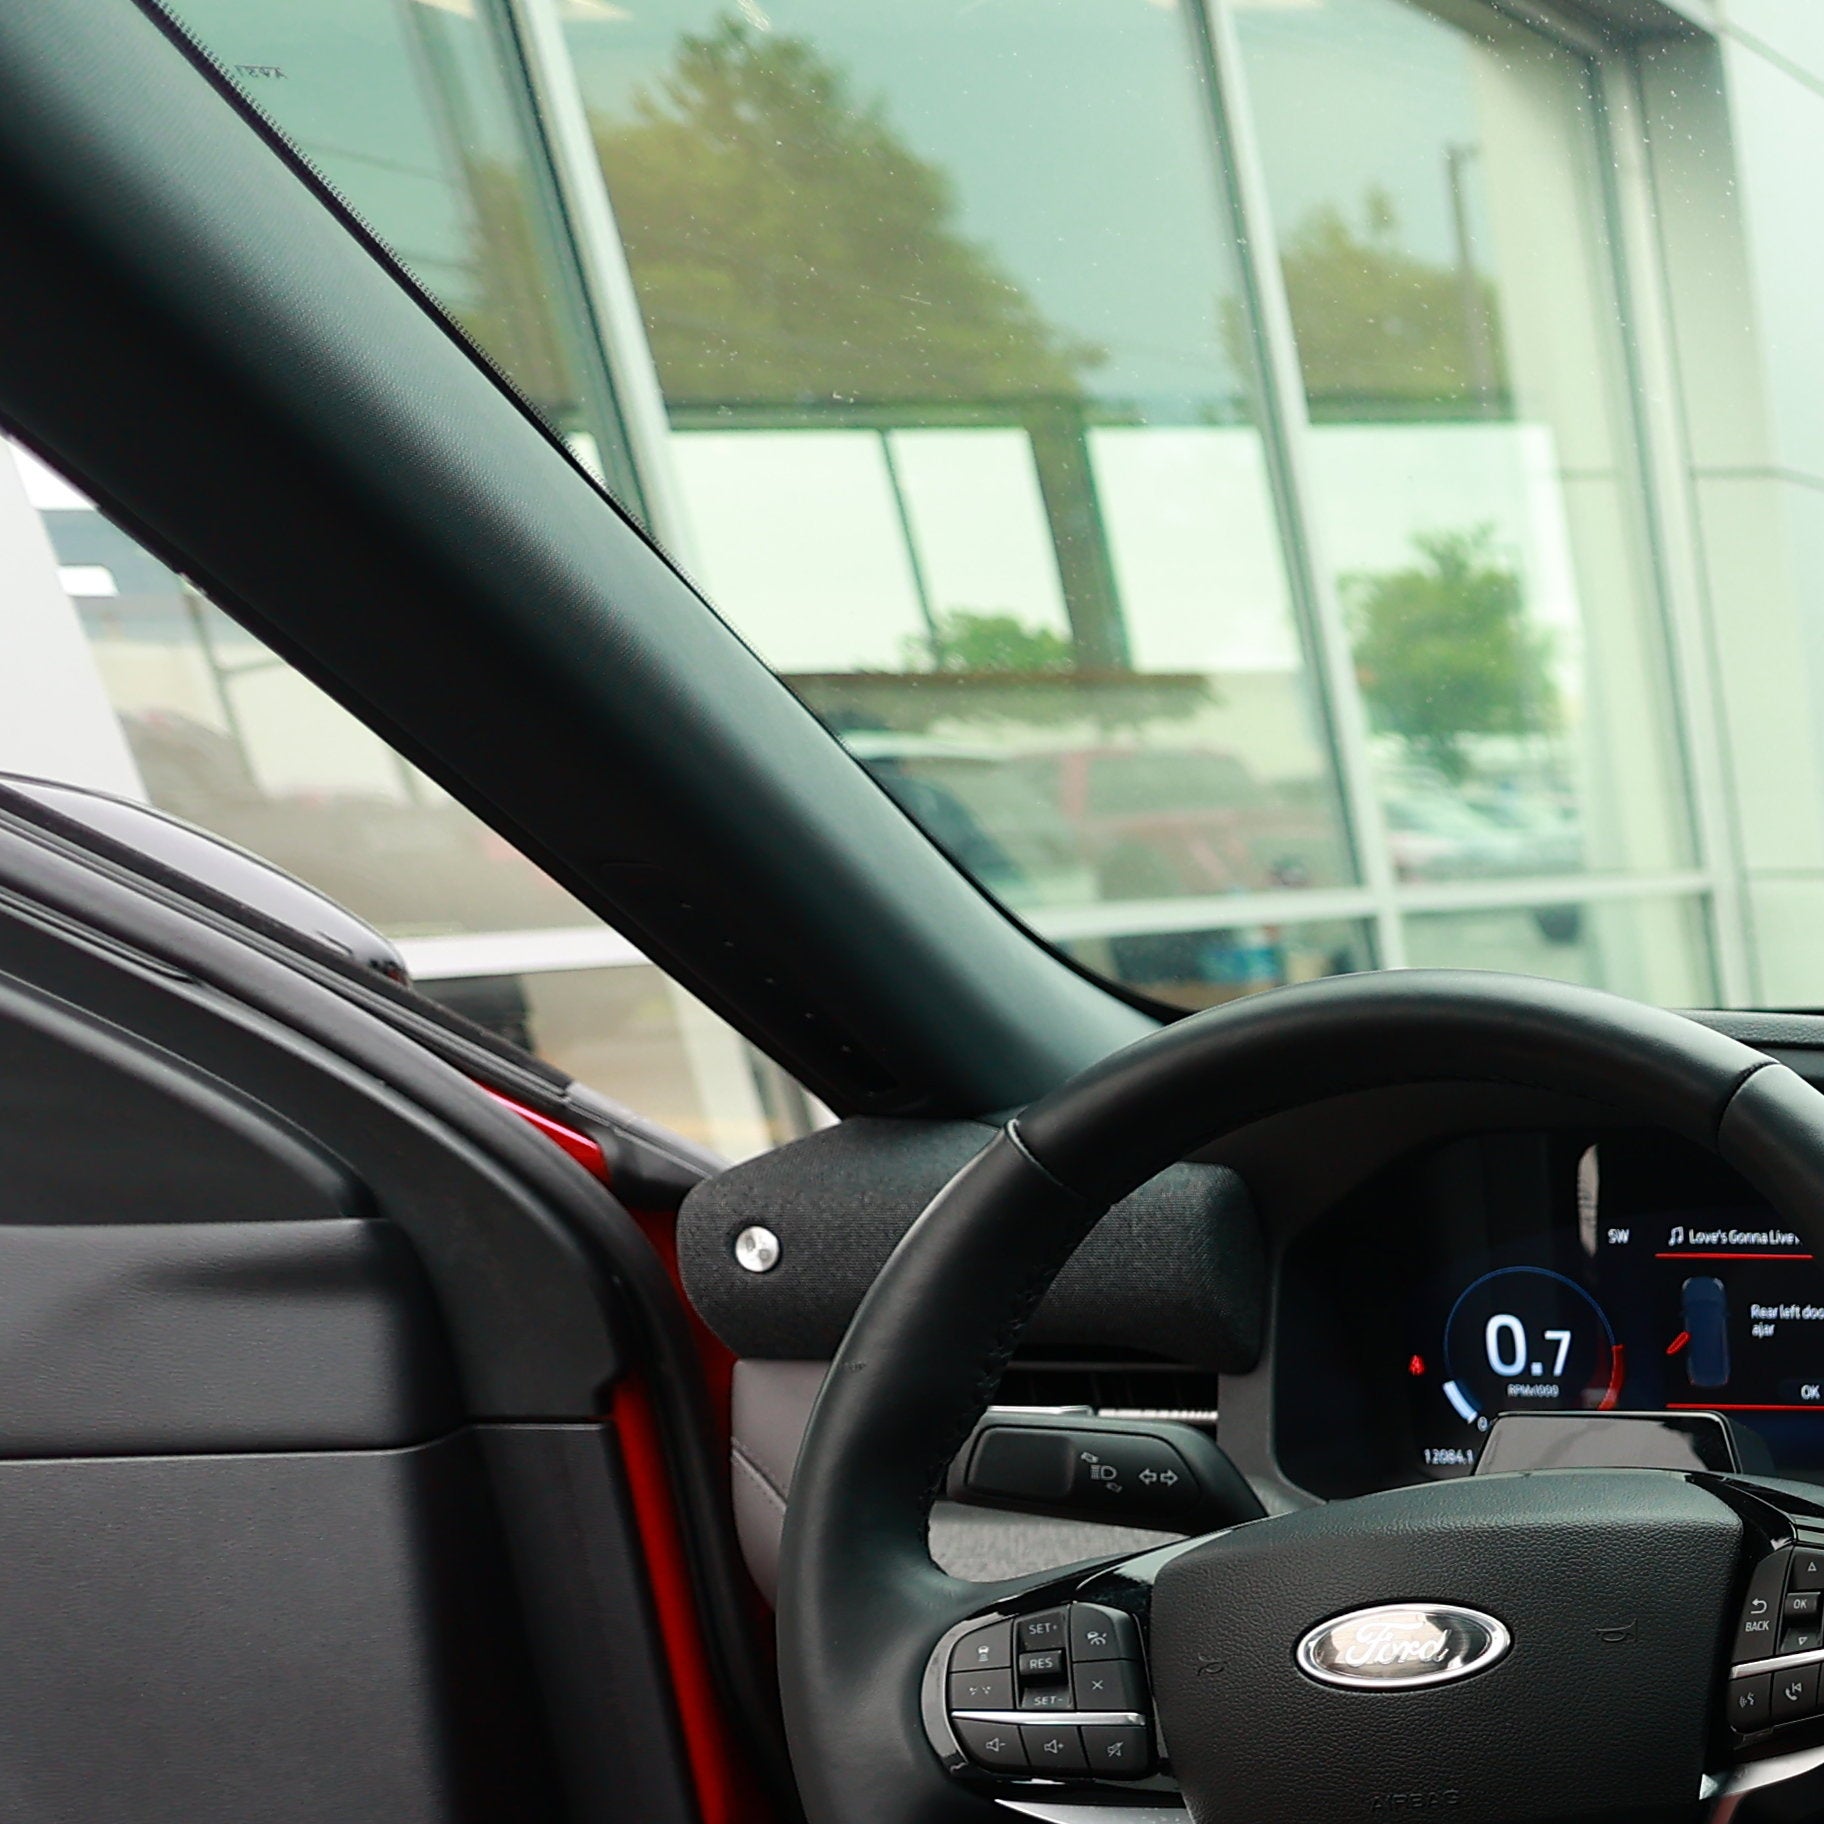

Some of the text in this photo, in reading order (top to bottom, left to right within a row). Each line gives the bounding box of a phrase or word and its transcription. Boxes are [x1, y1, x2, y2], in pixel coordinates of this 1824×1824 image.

[1608, 1229, 1630, 1245] SW
[1689, 1229, 1728, 1245] Love's
[1729, 1229, 1768, 1245] Gonna
[1769, 1229, 1795, 1245] Live
[1751, 1304, 1778, 1319] Rear
[1780, 1304, 1801, 1319] left
[1752, 1322, 1775, 1338] ajar
[1485, 1313, 1572, 1377] 0.7
[1800, 1384, 1821, 1400] OK
[1793, 1598, 1807, 1610] OK
[1745, 1620, 1770, 1633] BACK
[1345, 1621, 1452, 1668] Ford
[1029, 1657, 1053, 1669] RES
